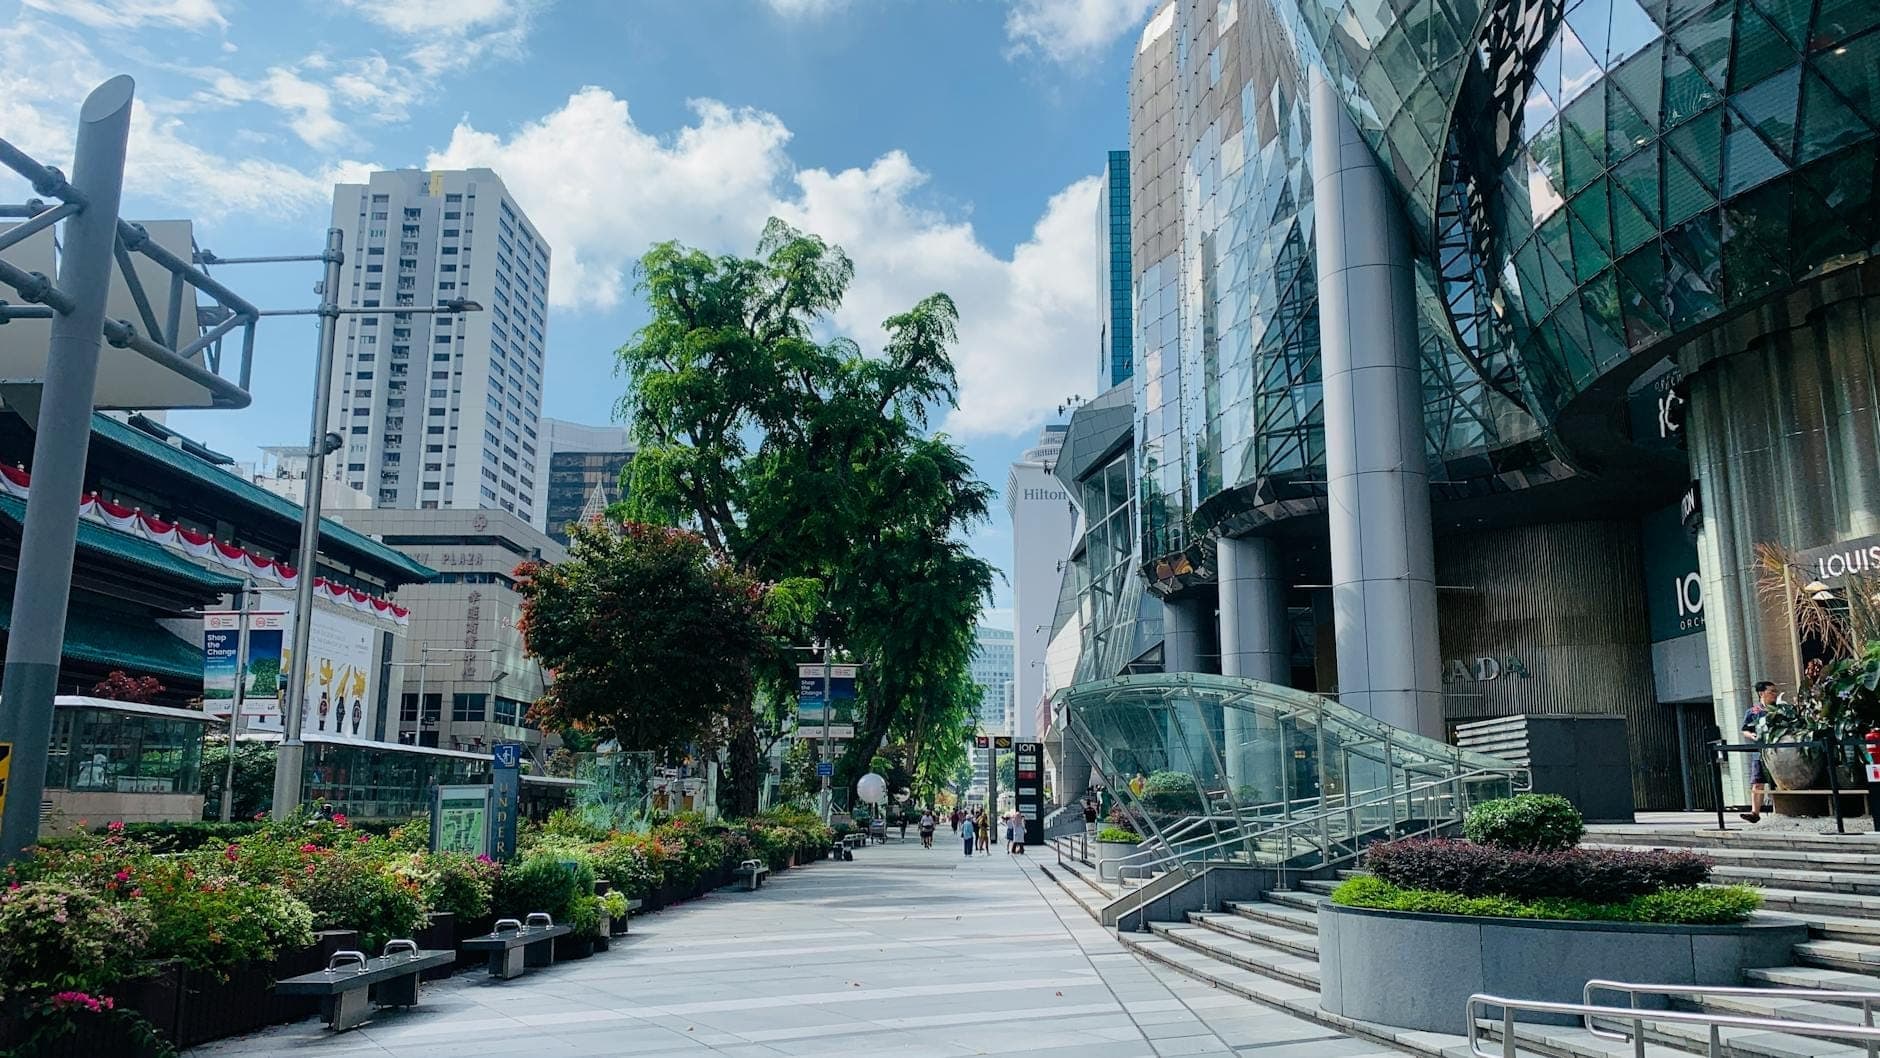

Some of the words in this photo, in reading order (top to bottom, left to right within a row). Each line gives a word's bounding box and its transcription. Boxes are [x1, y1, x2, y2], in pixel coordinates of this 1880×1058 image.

[1024, 489, 1066, 500] Hilton
[441, 552, 483, 566] PLAZA
[1818, 546, 1880, 579] LOUIS
[207, 634, 227, 643] Shop
[207, 648, 237, 657] Change
